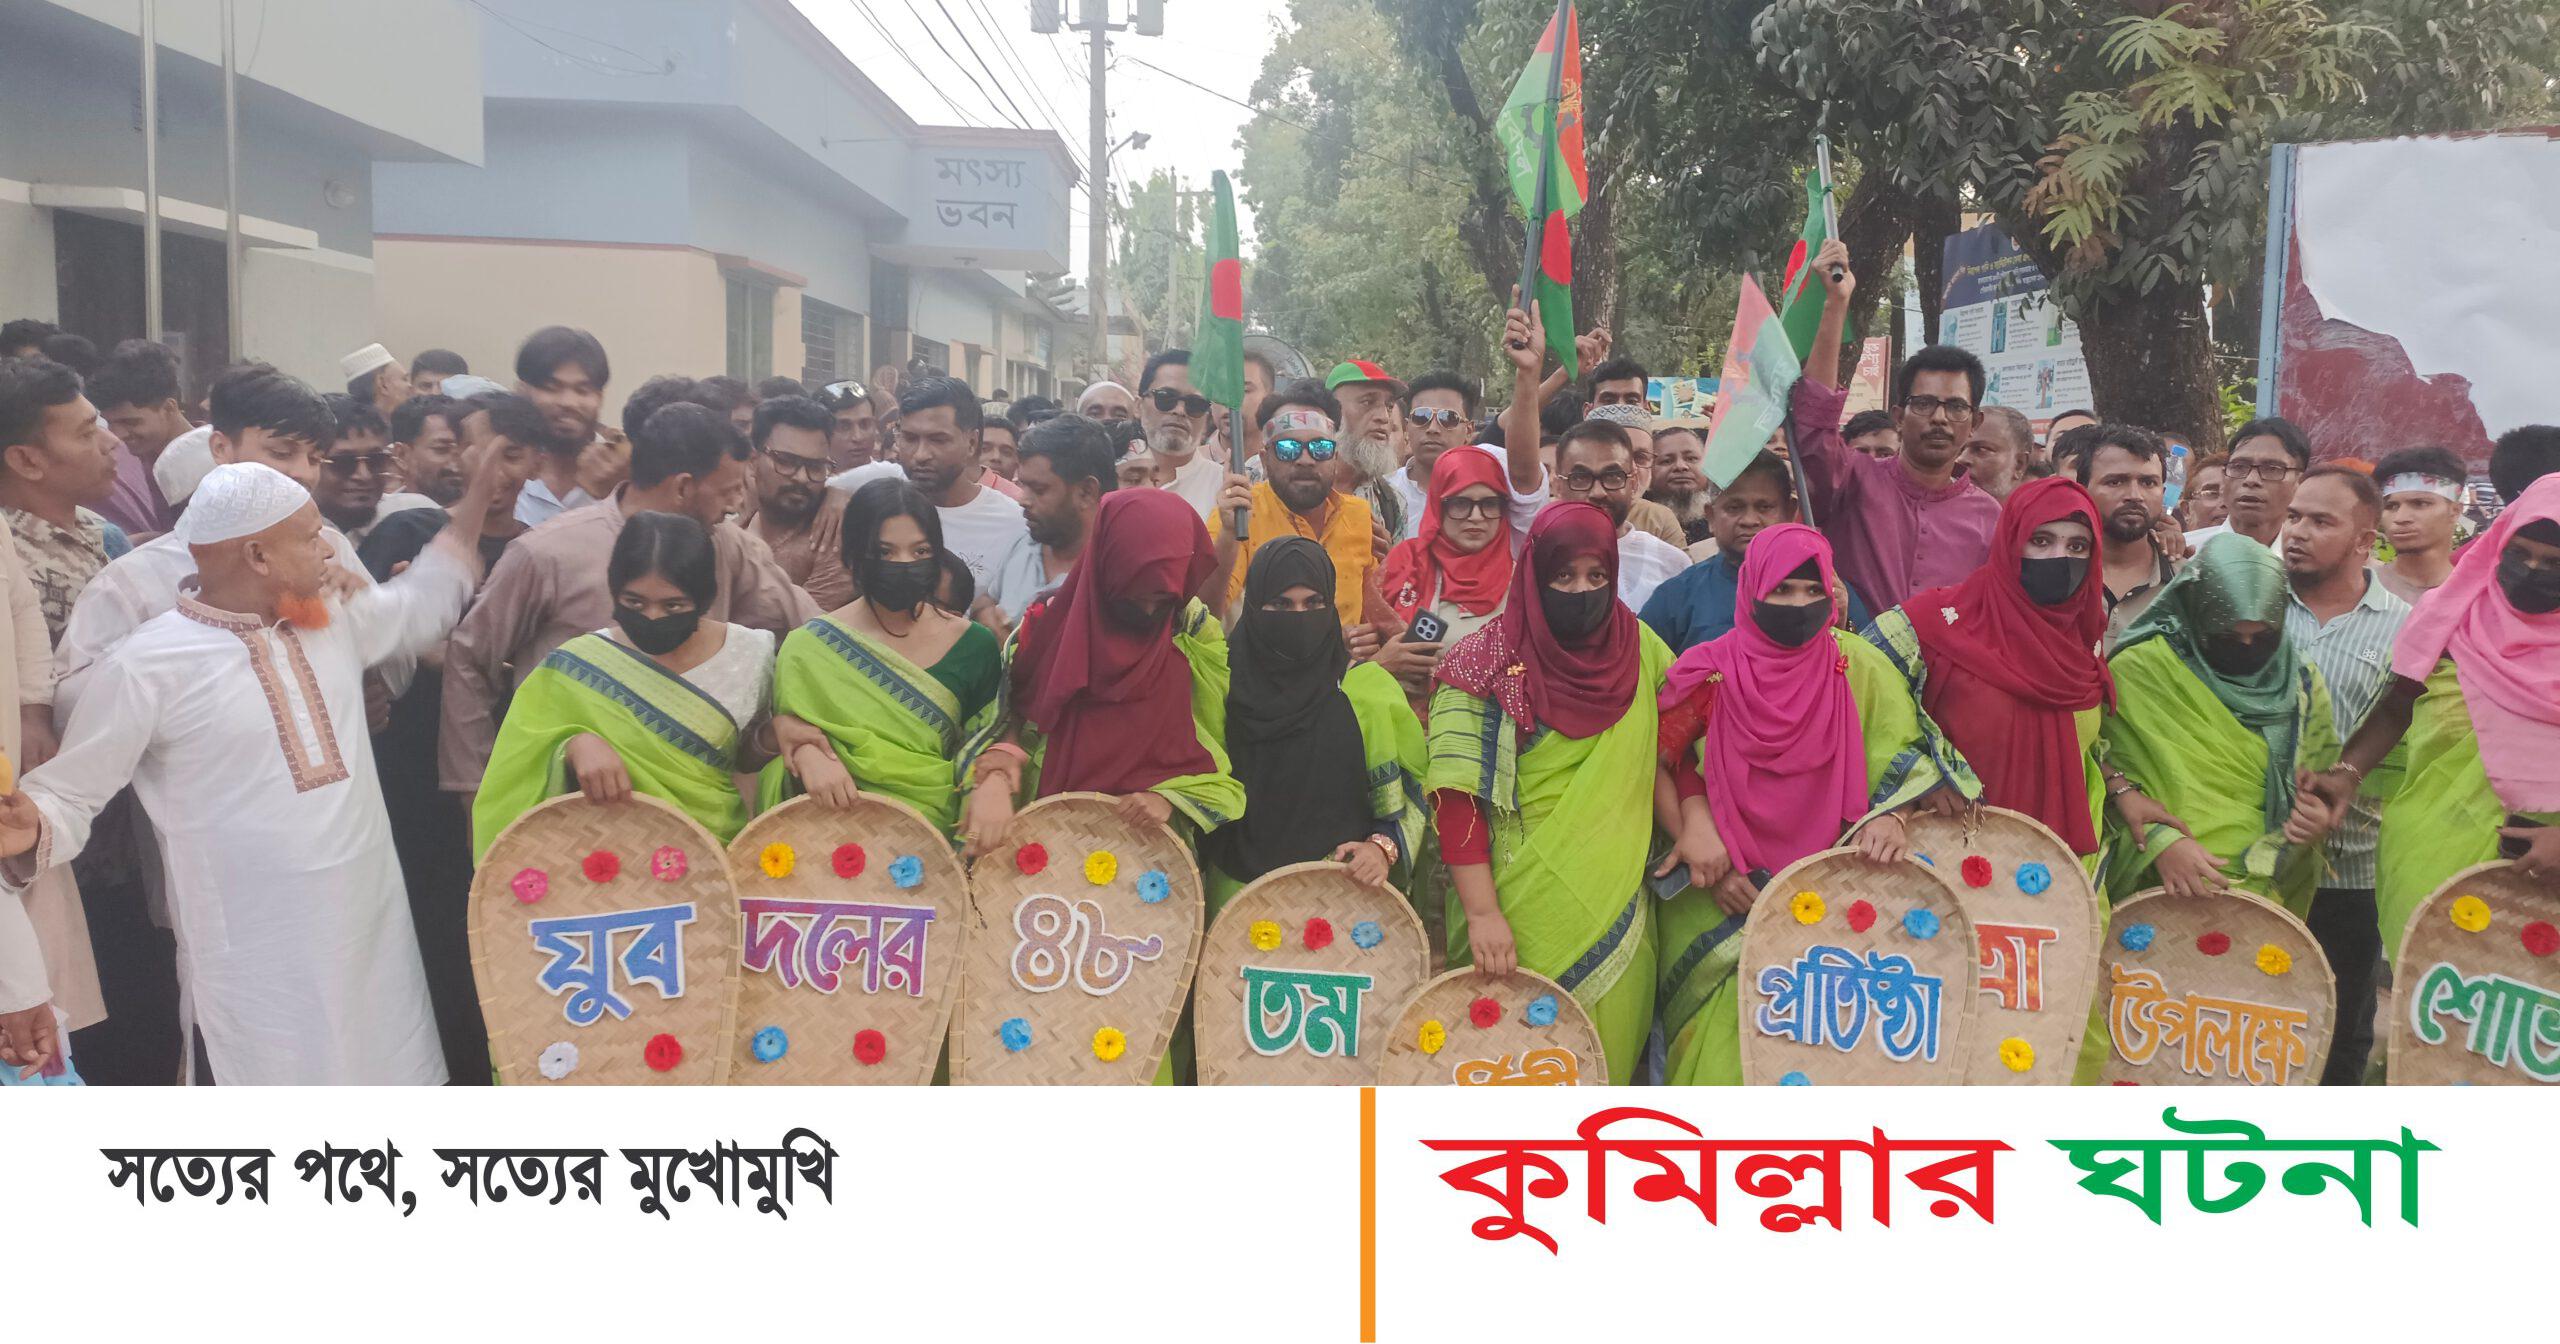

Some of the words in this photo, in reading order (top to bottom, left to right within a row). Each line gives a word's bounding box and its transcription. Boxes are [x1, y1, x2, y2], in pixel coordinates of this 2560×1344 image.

[934, 157, 1026, 188] মৎস্য
[936, 199, 1018, 230] ভবন
[528, 901, 697, 1027] যুব
[740, 896, 936, 997] দলের
[1011, 894, 1163, 996] ৪৮
[1240, 965, 1374, 1057] তম
[1757, 945, 1943, 1063] প্রতিষ্ঠা
[2109, 963, 2308, 1085] উপলক্ষে
